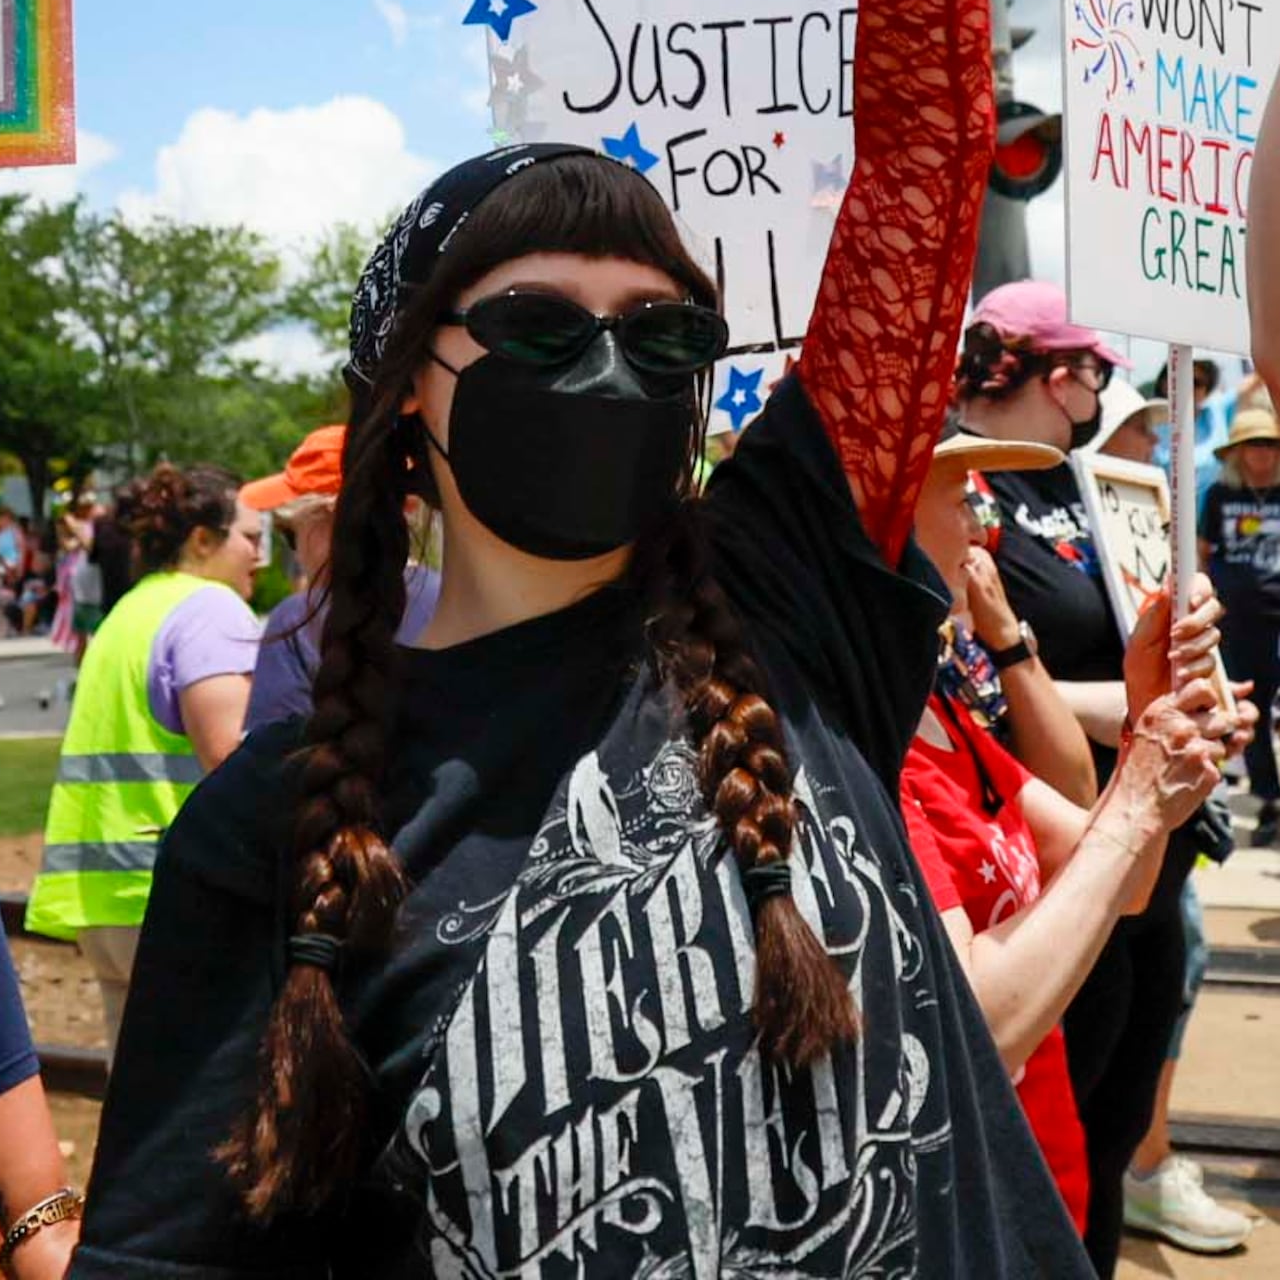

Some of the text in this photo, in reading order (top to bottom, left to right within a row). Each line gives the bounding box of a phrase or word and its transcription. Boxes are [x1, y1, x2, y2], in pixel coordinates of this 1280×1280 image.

[1156, 48, 1258, 143] MAKE
[666, 129, 781, 211] FOR
[1091, 112, 1254, 218] AMERIC
[714, 230, 807, 354] LL
[1140, 206, 1246, 299] GREA
